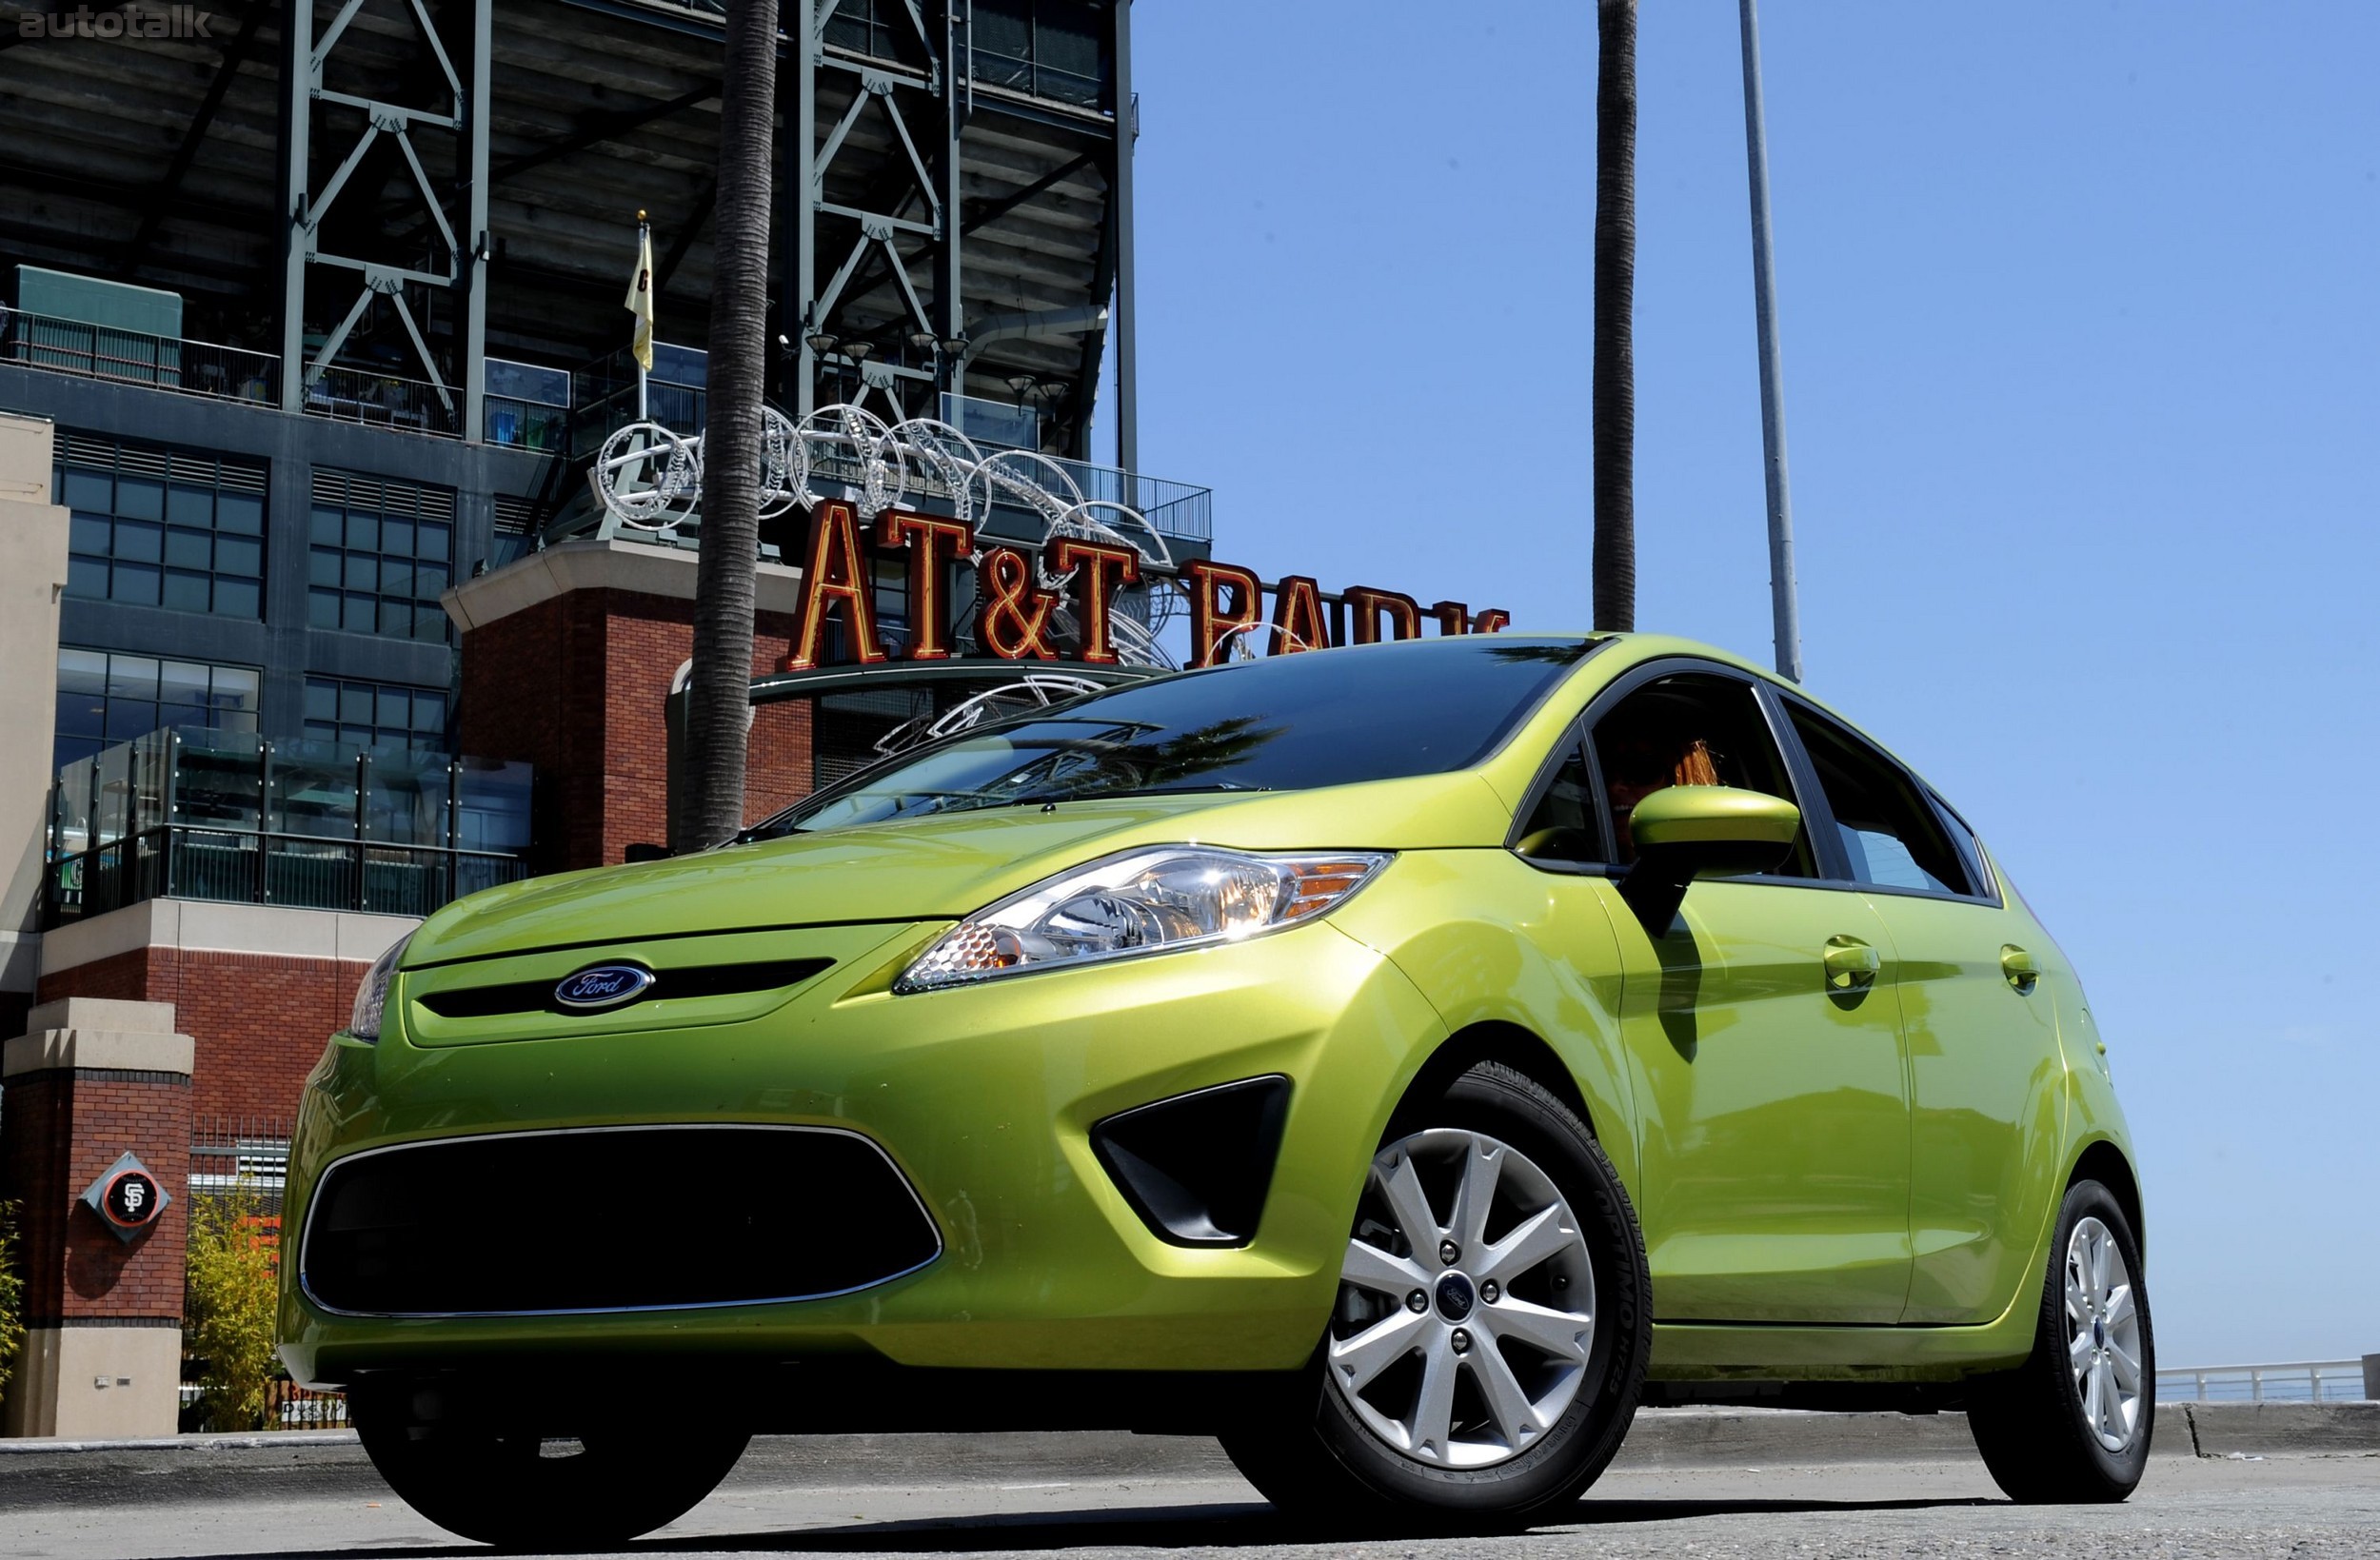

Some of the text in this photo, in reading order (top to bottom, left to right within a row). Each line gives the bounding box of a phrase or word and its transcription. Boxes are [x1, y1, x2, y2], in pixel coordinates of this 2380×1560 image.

[784, 498, 1140, 671] AT&T
[572, 972, 625, 997] Ford
[1594, 1189, 1636, 1331] OPTIMO
